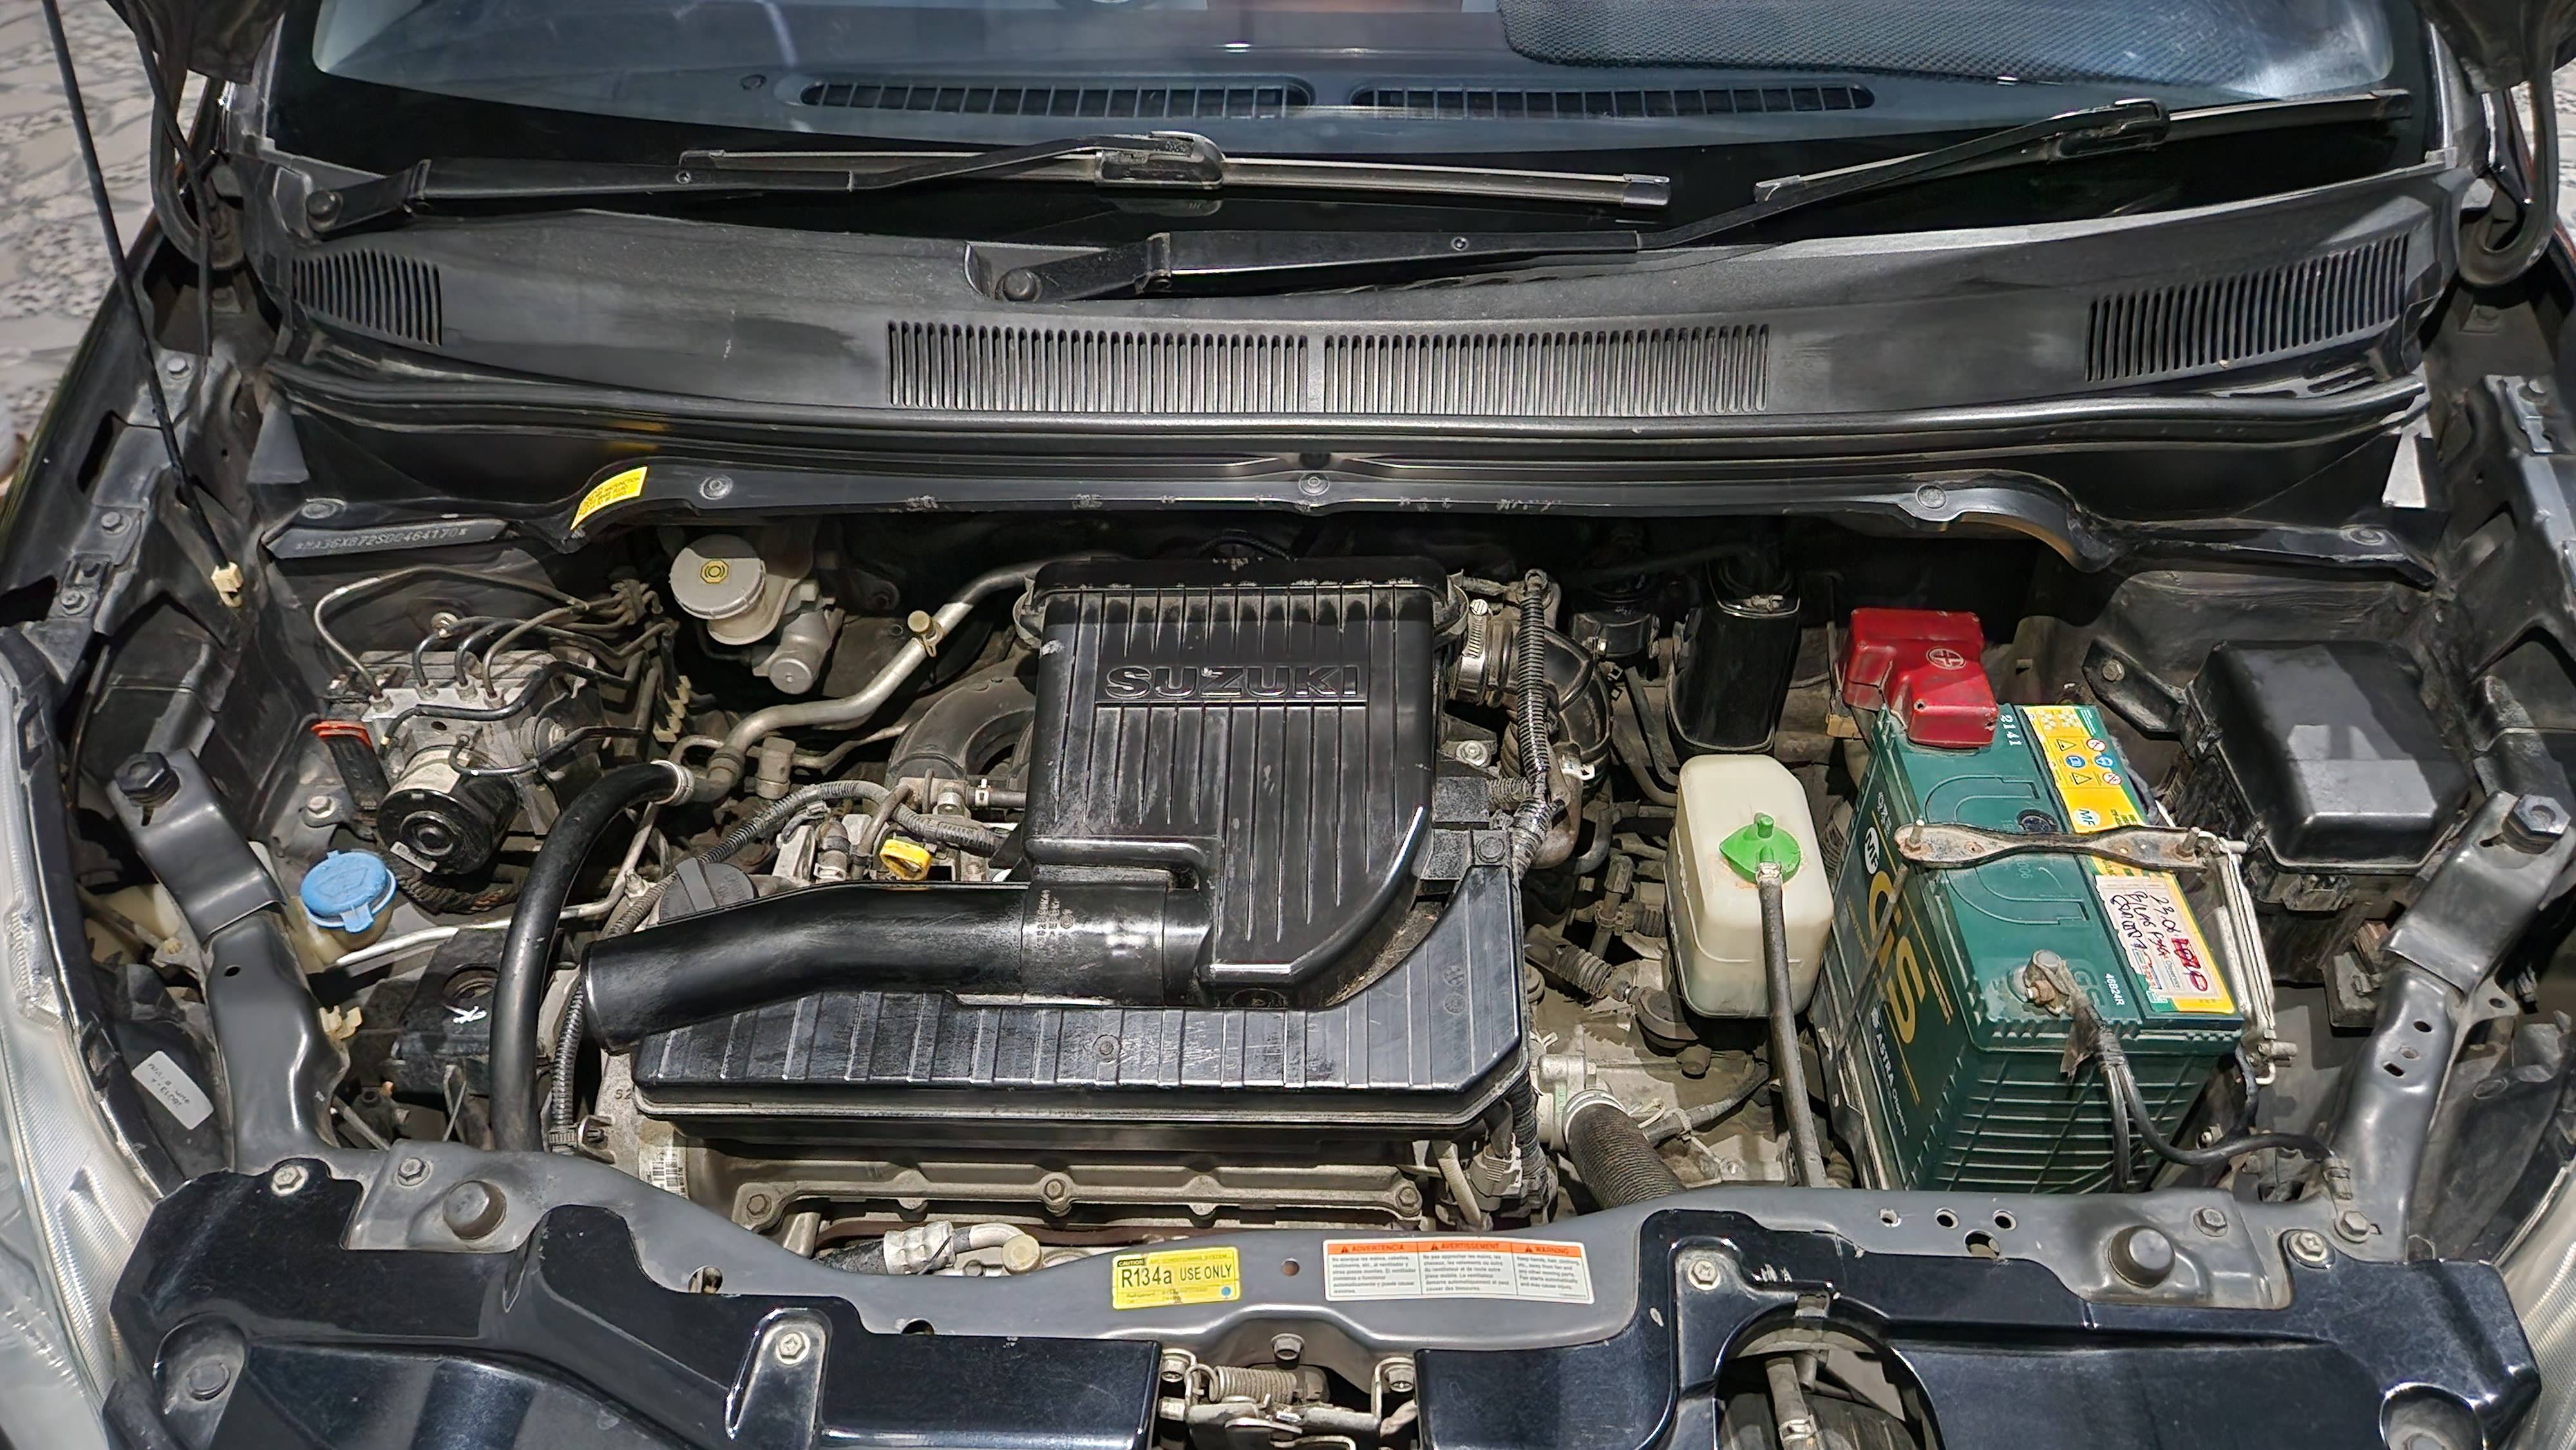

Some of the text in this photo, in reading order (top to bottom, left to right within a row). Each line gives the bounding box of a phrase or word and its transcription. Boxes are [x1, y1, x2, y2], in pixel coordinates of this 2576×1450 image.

[1104, 664, 1359, 699] SUZUKI
[2000, 714, 2022, 746] 2141
[2078, 808, 2096, 827] MF
[1865, 834, 1880, 867] MF
[2105, 972, 2125, 1006] 46B24R
[1875, 1033, 1895, 1088] ASTRA
[1352, 1244, 1405, 1252] ADVERTENCIA
[1535, 1247, 1570, 1255] WARNING
[1121, 1263, 1232, 1288] R134a USE ONLY
